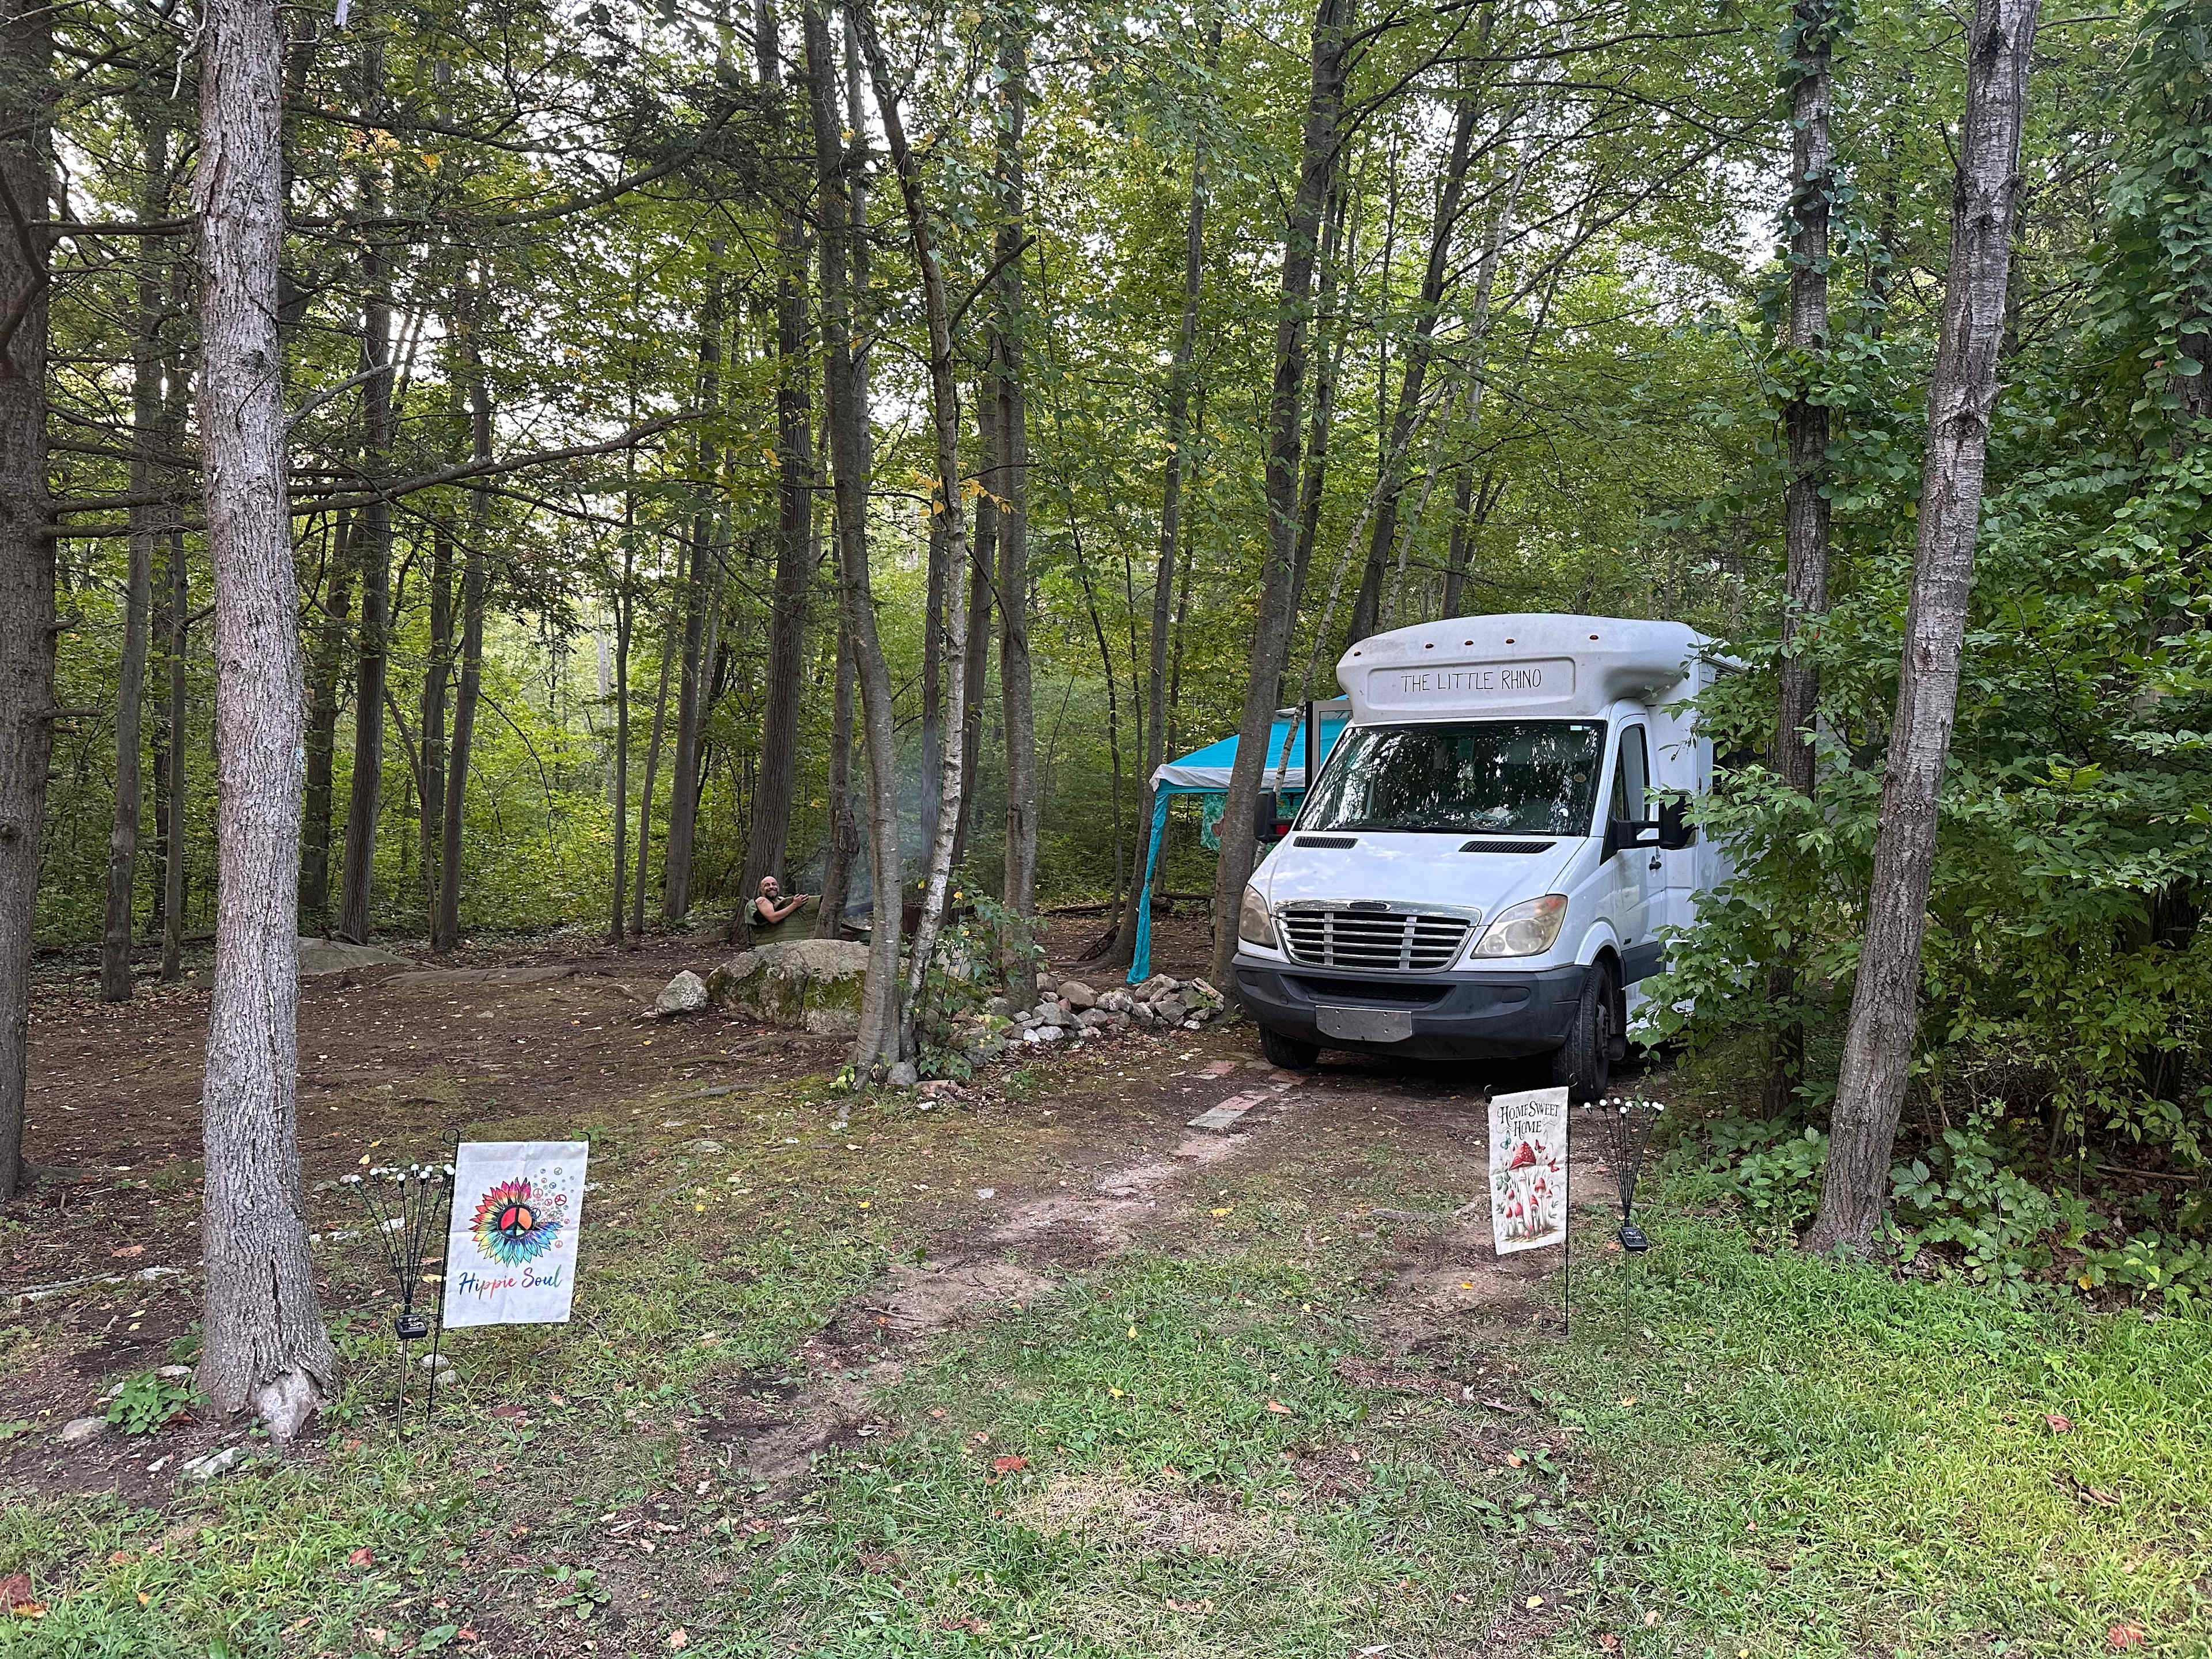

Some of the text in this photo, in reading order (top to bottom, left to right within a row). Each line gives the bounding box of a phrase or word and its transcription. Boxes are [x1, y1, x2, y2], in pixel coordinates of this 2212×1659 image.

[1400, 668, 1542, 693] THE LITTLE RHINO
[459, 1264, 563, 1300] Hippie Soul
